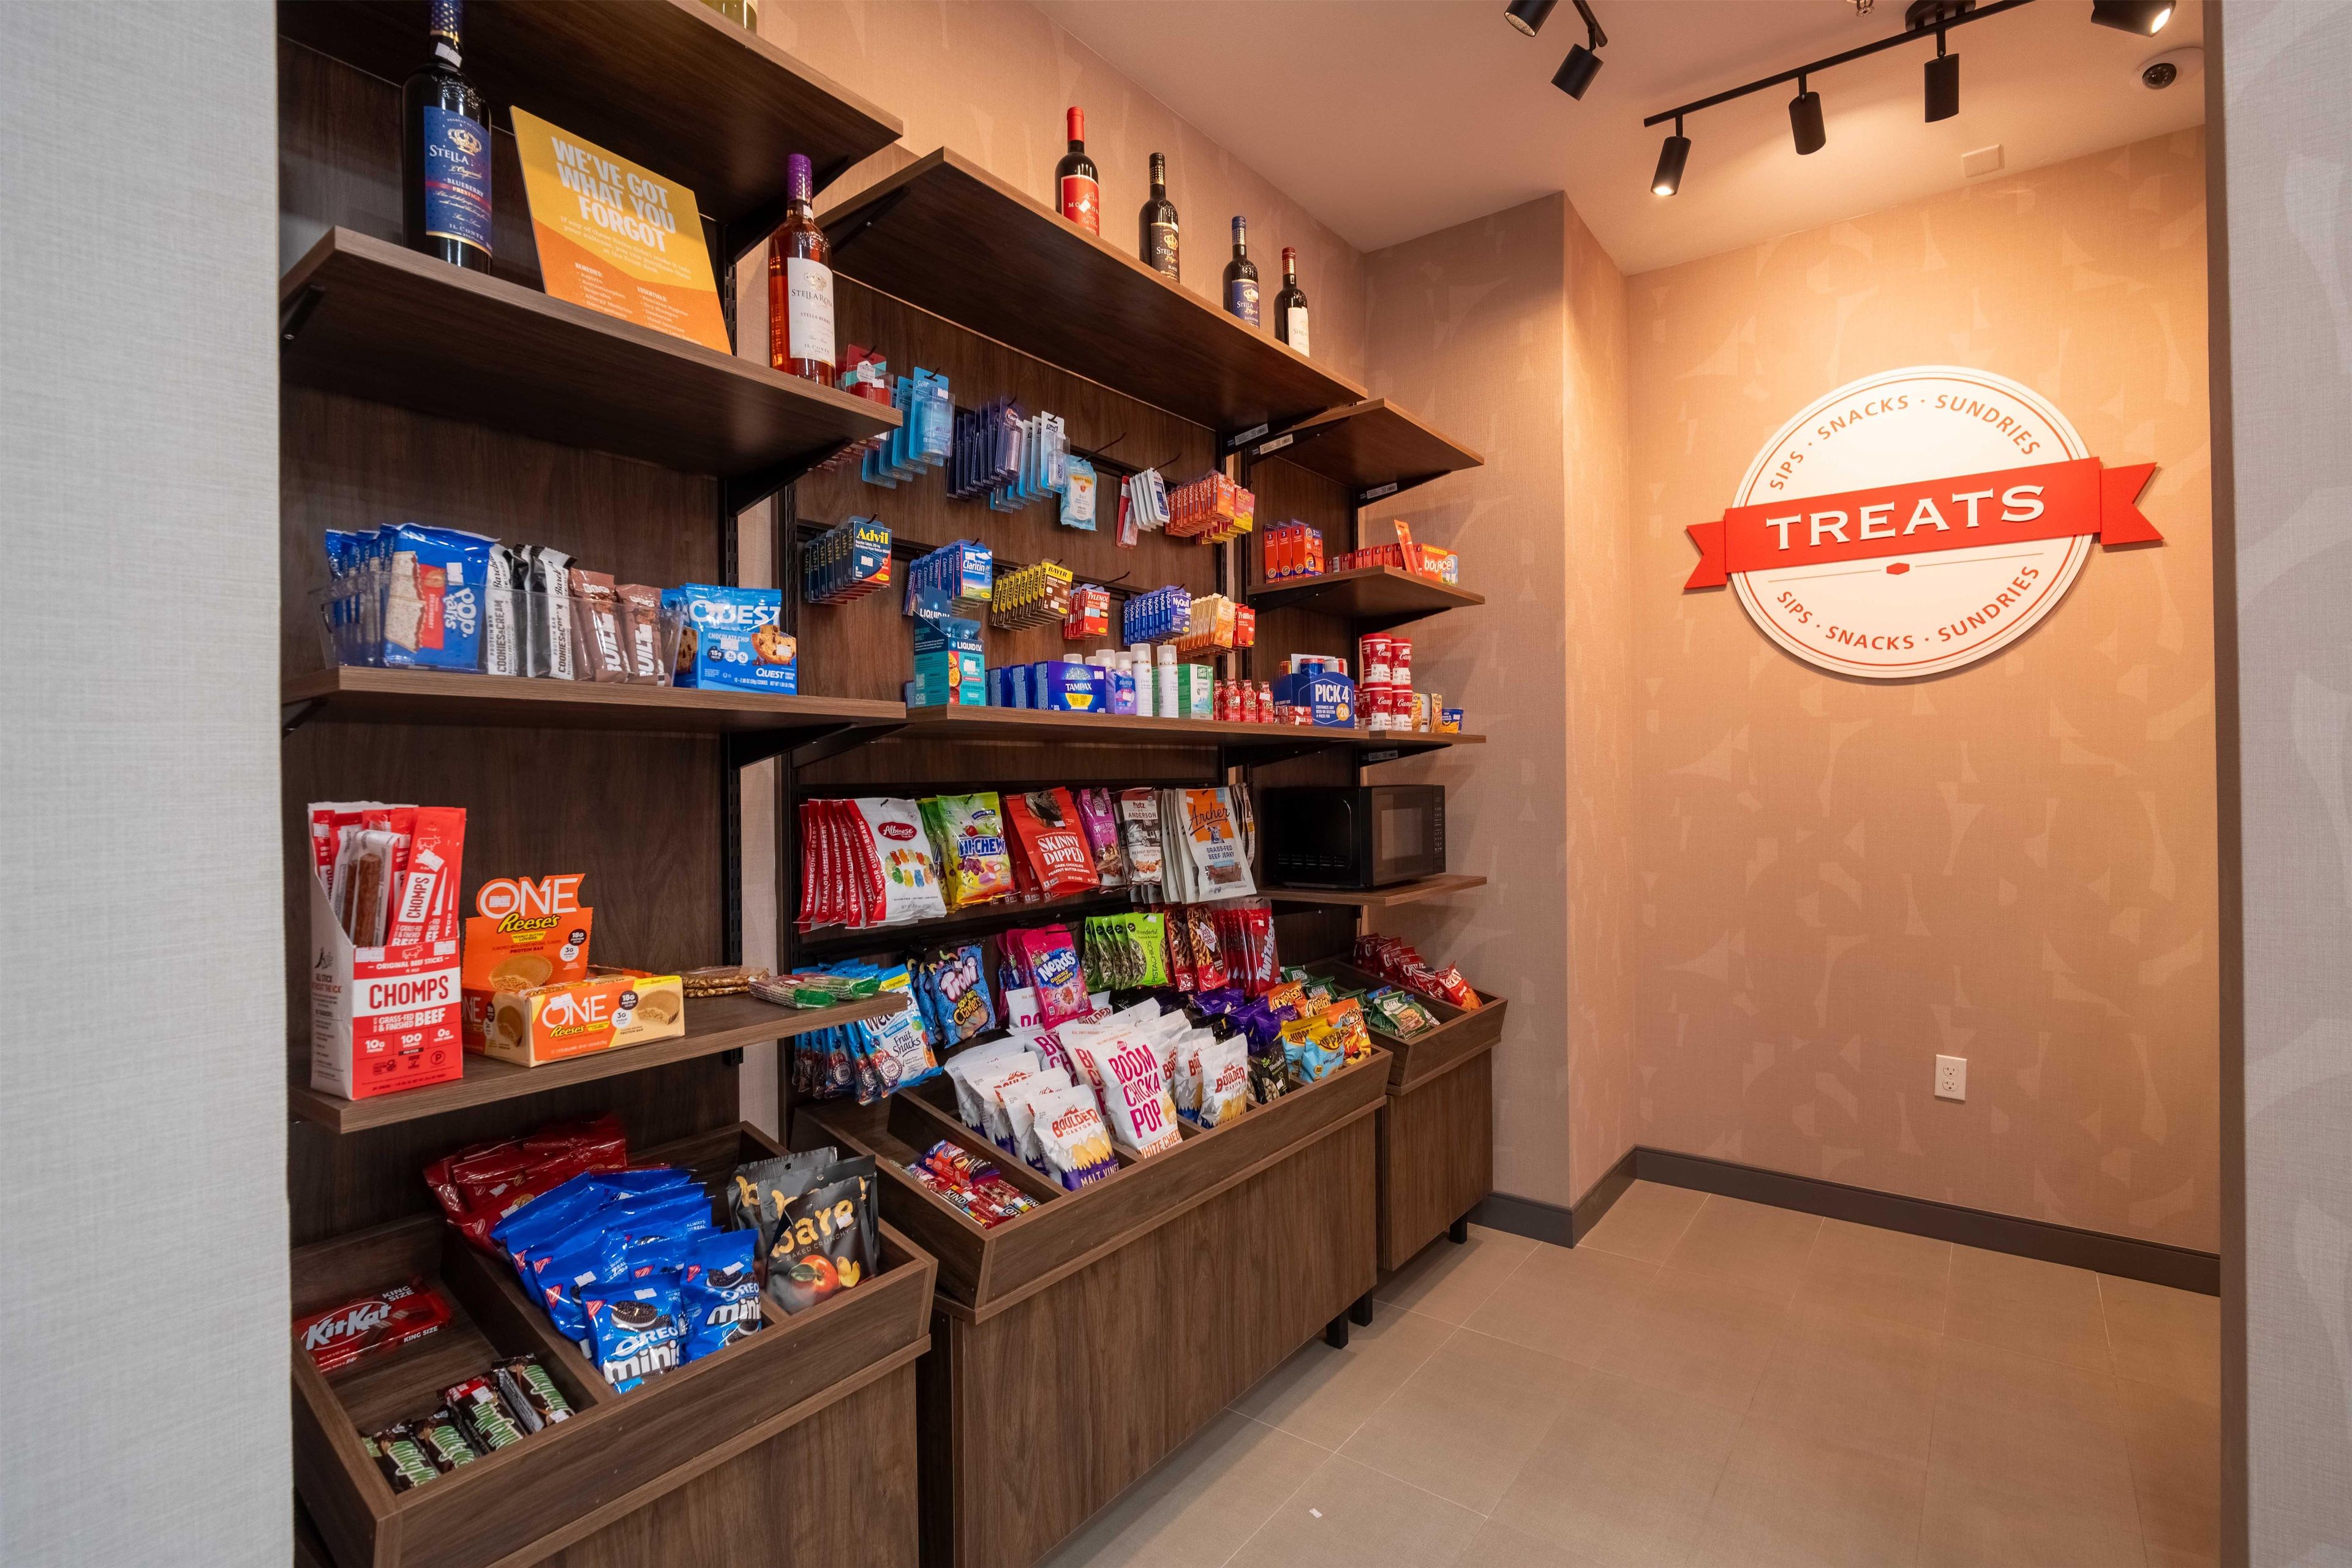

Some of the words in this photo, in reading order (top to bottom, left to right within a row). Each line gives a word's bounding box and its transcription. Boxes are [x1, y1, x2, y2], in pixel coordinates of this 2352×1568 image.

[429, 145, 469, 165] STELLA
[552, 136, 624, 189] WE'VE
[627, 173, 668, 209] GOT
[447, 178, 484, 197] BLUEBERRY
[556, 162, 624, 211] WHAT
[629, 194, 676, 233] YOU
[578, 195, 666, 252] FORGOT
[460, 225, 484, 241] CONTE
[1156, 247, 1174, 257] STELLA
[791, 289, 818, 301] STELLA
[1770, 450, 1804, 491] SIPS
[1817, 394, 1910, 440] SNACKS
[1935, 394, 2041, 456] SUNDRIES
[1219, 480, 1234, 492] DayQuil
[1238, 491, 1251, 501] Pepto
[1766, 484, 2046, 551] TREATS
[856, 527, 888, 544] Advil
[963, 560, 985, 571] Claritin
[1048, 566, 1067, 578] BAYER
[1088, 592, 1109, 603] TYLENOL
[1173, 598, 1189, 608] NyQuil
[442, 594, 456, 630] tarts
[456, 587, 477, 635] pop
[690, 600, 781, 625] QUEST
[1776, 590, 1814, 625] SIPS
[1826, 626, 1915, 651] SNACKS
[1937, 566, 2040, 643] SUNDRIES
[496, 600, 506, 673] COOKIES&CREAM
[957, 642, 976, 650] LIQUID
[756, 668, 785, 679] QUEST
[1065, 683, 1092, 692] TAMPAX
[1315, 684, 1341, 703] PICK
[1342, 686, 1349, 703] 4
[1337, 707, 1348, 717] $20
[1188, 802, 1230, 831] Archer
[859, 821, 869, 843] BEARS
[883, 825, 914, 835] Albanese
[959, 838, 1006, 855] HI-CHEW
[1038, 835, 1080, 853] SKINNY
[1043, 847, 1085, 865] DIPPED
[406, 877, 430, 919] CHOMPS
[480, 878, 578, 919] ONE
[497, 913, 560, 933] Reese's
[376, 961, 409, 970] ORIGINAL
[1038, 951, 1076, 981] Nerds
[1146, 941, 1158, 982] PISTACHIOS
[941, 957, 978, 1000] Trolli
[369, 976, 448, 1009] CHOMPS
[541, 994, 609, 1028] ONE
[954, 997, 982, 1026] Crawlers
[1384, 998, 1398, 1008] TATE'S
[379, 1014, 413, 1025] GRASS-FED
[385, 1021, 413, 1031] FINISHED
[415, 1008, 446, 1027] BEEF
[896, 1020, 907, 1030] FRUIT
[401, 1033, 422, 1044] 100
[549, 1025, 585, 1038] Reese's
[894, 1030, 913, 1046] Fruit
[893, 1038, 921, 1058] Snacks
[1108, 1044, 1158, 1085] BOOM
[1268, 1055, 1285, 1071] Wonderful
[1215, 1066, 1245, 1093] BOULDER
[1226, 1082, 1242, 1091] CANYON
[1123, 1072, 1162, 1107] CHICKA
[1052, 1108, 1102, 1138] BOULDER
[1130, 1098, 1163, 1139] POP
[1066, 1122, 1091, 1136] CANYON
[1137, 1143, 1164, 1159] WHITE
[1080, 1171, 1101, 1186] MALT
[944, 1189, 966, 1204] KIND
[686, 1219, 706, 1228] ALWAYS
[786, 1246, 812, 1261] BAKED
[813, 1229, 850, 1250] CRUNCHY
[382, 1286, 410, 1298] KING
[390, 1290, 414, 1302] SIZE
[720, 1282, 760, 1304] OREO
[404, 1333, 421, 1343] KING
[423, 1325, 438, 1336] SIZE
[615, 1325, 679, 1357] OREO
